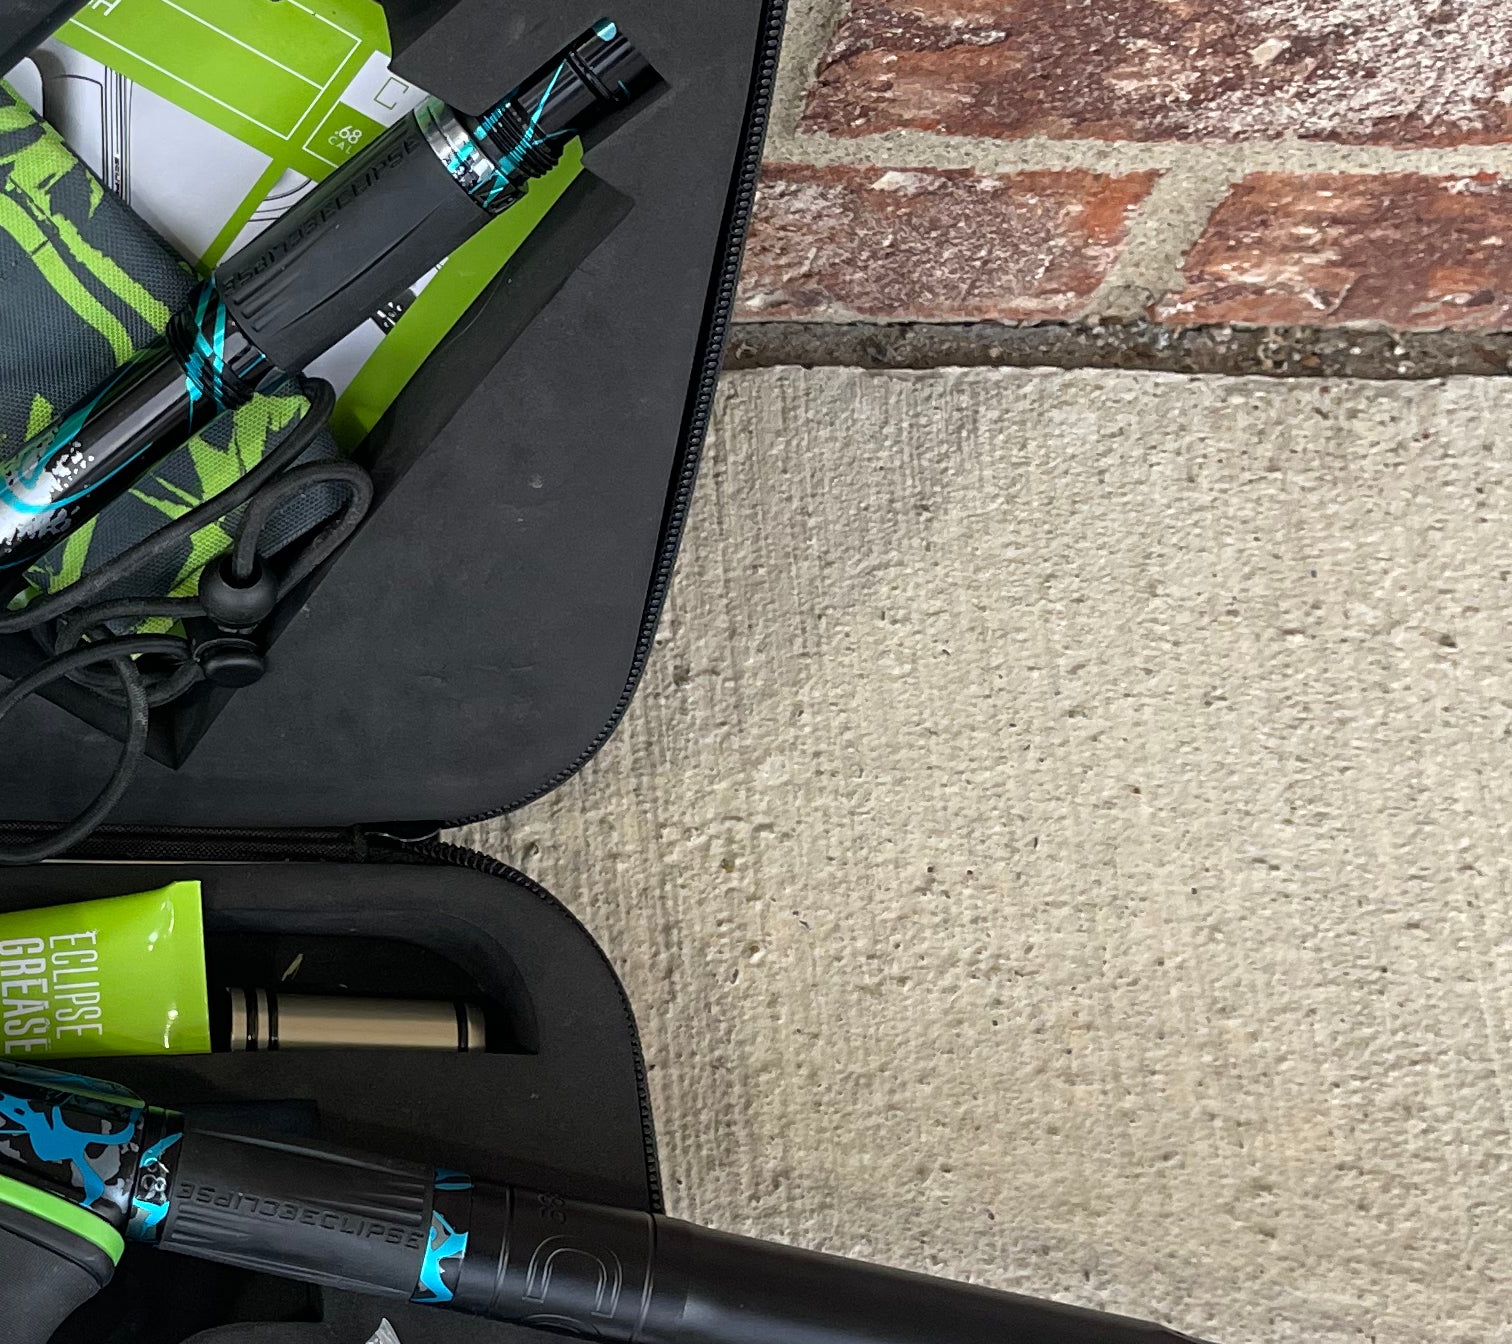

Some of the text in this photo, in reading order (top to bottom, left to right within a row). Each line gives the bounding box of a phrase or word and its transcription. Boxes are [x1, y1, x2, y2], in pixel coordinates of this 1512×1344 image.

[328, 136, 351, 154] CAL
[335, 126, 362, 144] .68
[49, 928, 103, 1039] ECLIPSE
[298, 1210, 425, 1250] ECLIPSE
